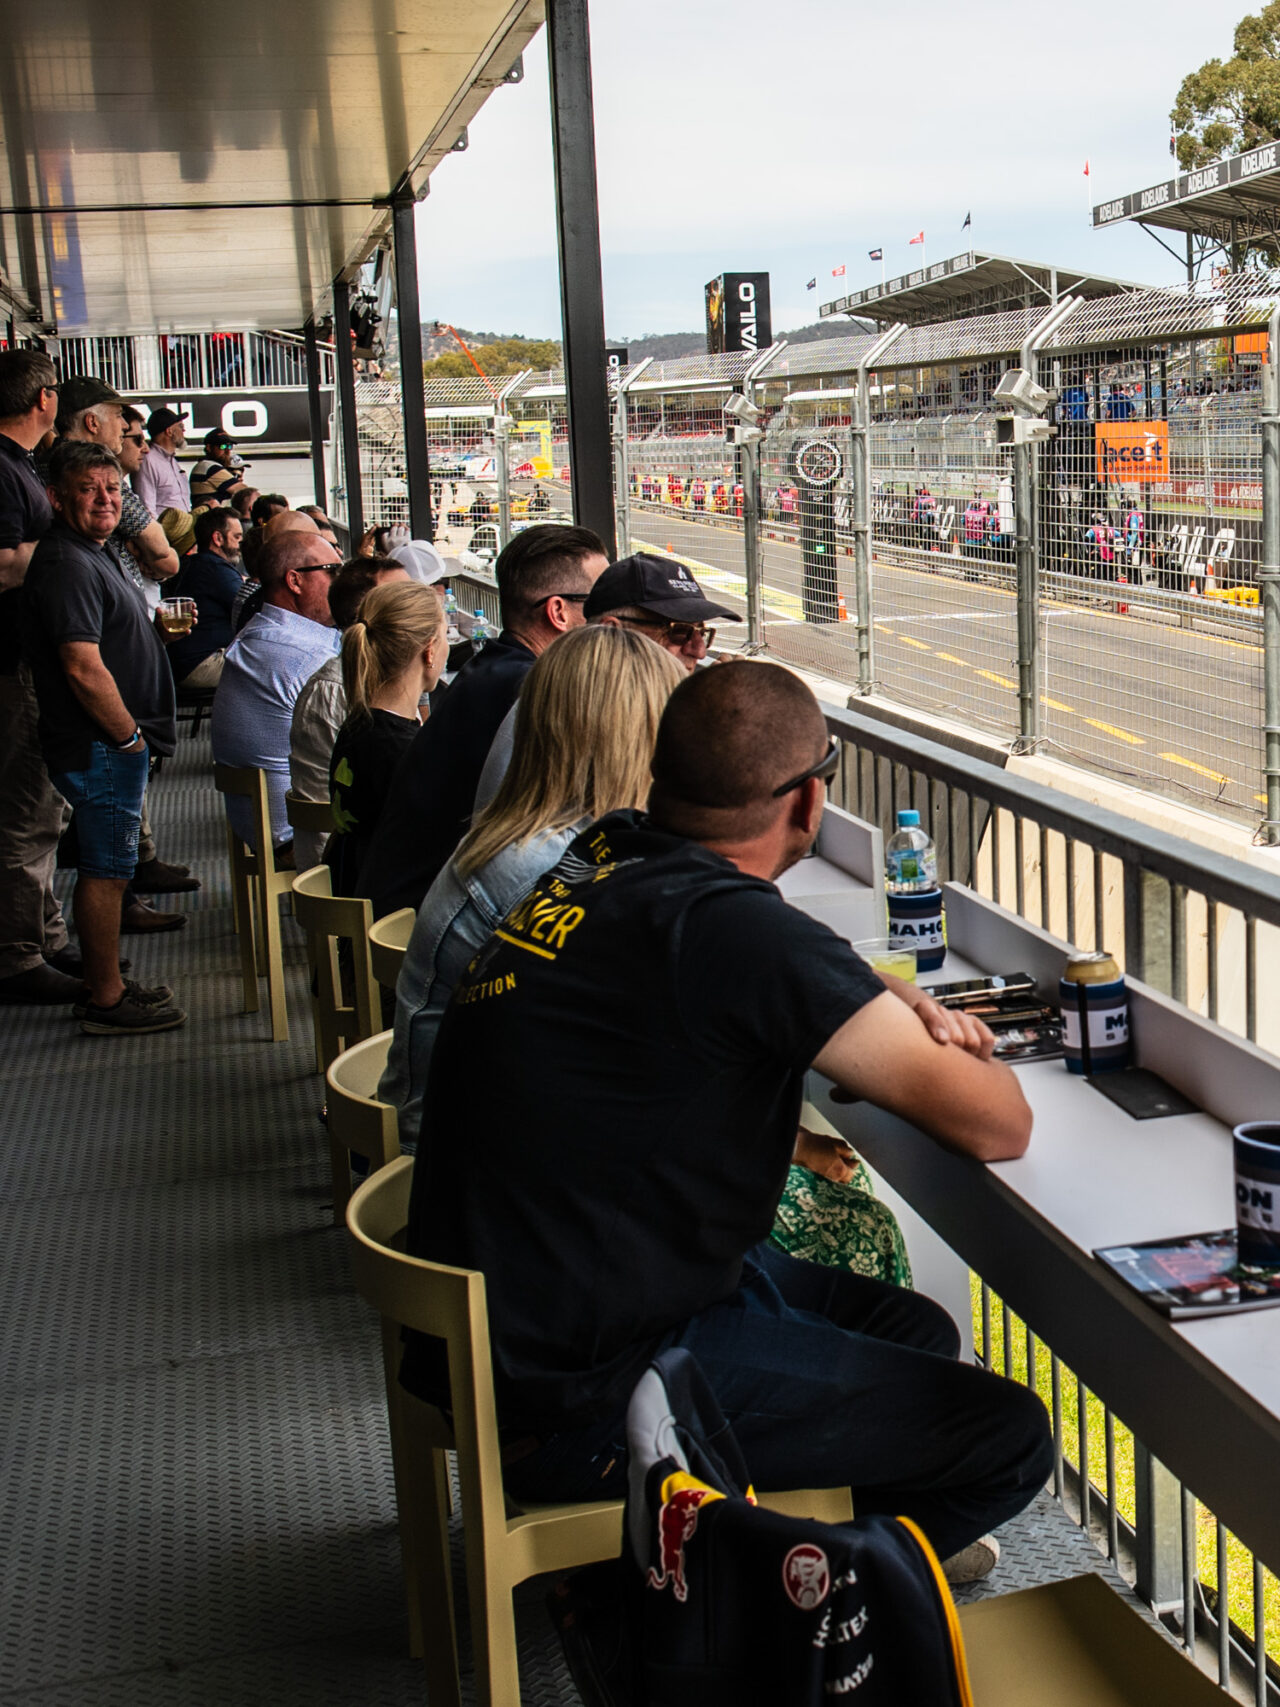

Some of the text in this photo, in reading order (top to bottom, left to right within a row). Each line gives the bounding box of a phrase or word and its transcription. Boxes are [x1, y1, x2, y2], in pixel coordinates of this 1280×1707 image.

[1241, 147, 1276, 177] ADELAIDE
[1188, 166, 1219, 194] ADELAIDE
[1141, 184, 1169, 209] ADELAIDE
[1099, 200, 1125, 222] ADELAIDE
